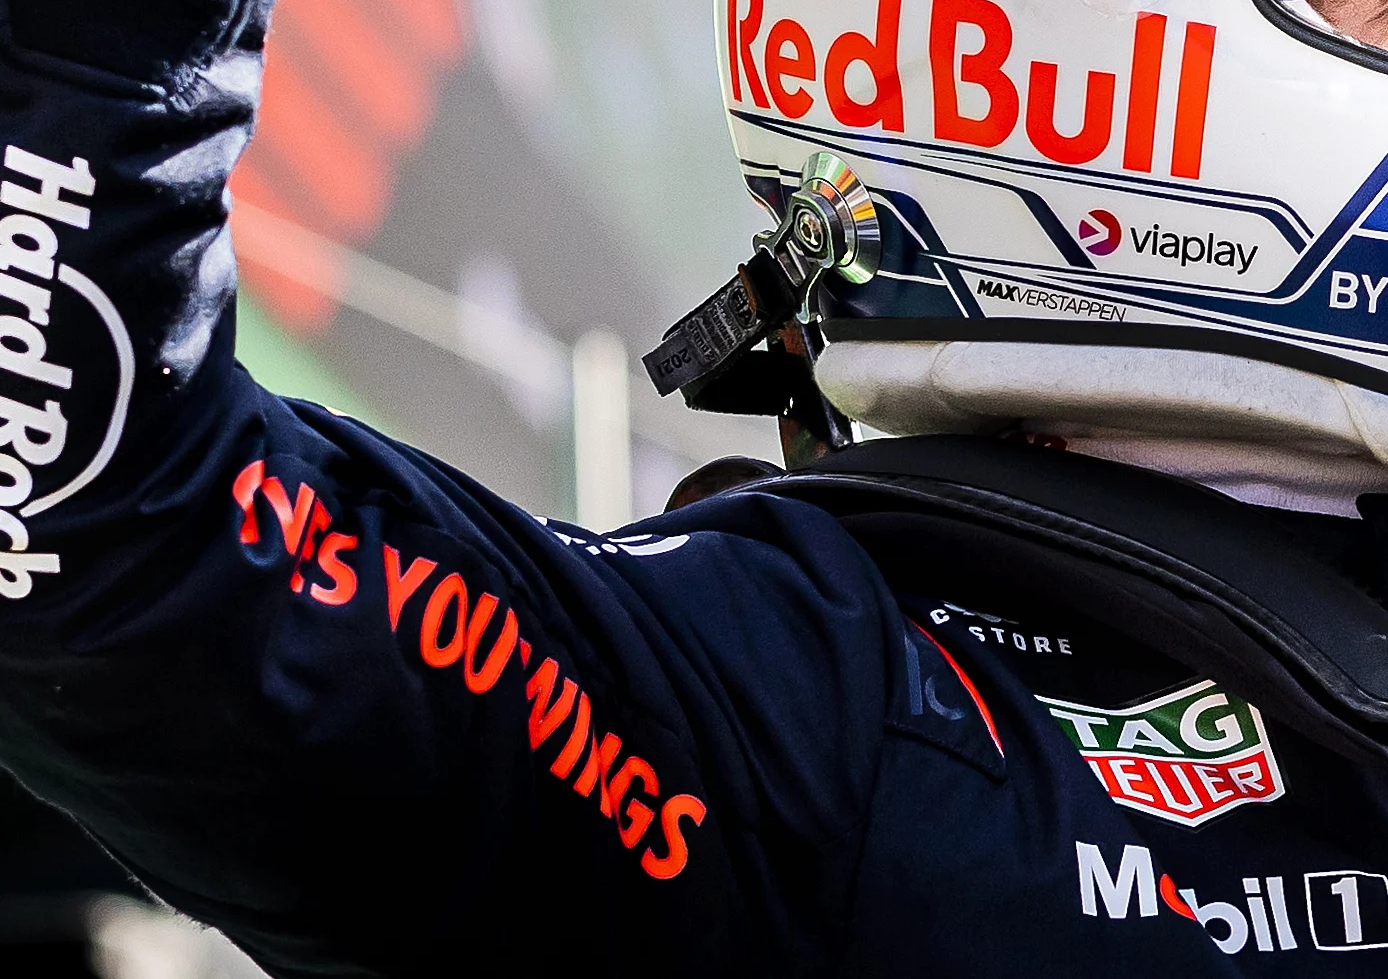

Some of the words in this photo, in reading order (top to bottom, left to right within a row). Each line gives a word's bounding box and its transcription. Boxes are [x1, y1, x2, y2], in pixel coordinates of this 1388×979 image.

[0, 145, 96, 390] Hard
[1129, 224, 1260, 275] viaplay
[383, 542, 519, 694] YOU
[519, 638, 707, 879] WINGS
[1049, 692, 1244, 754] TAG
